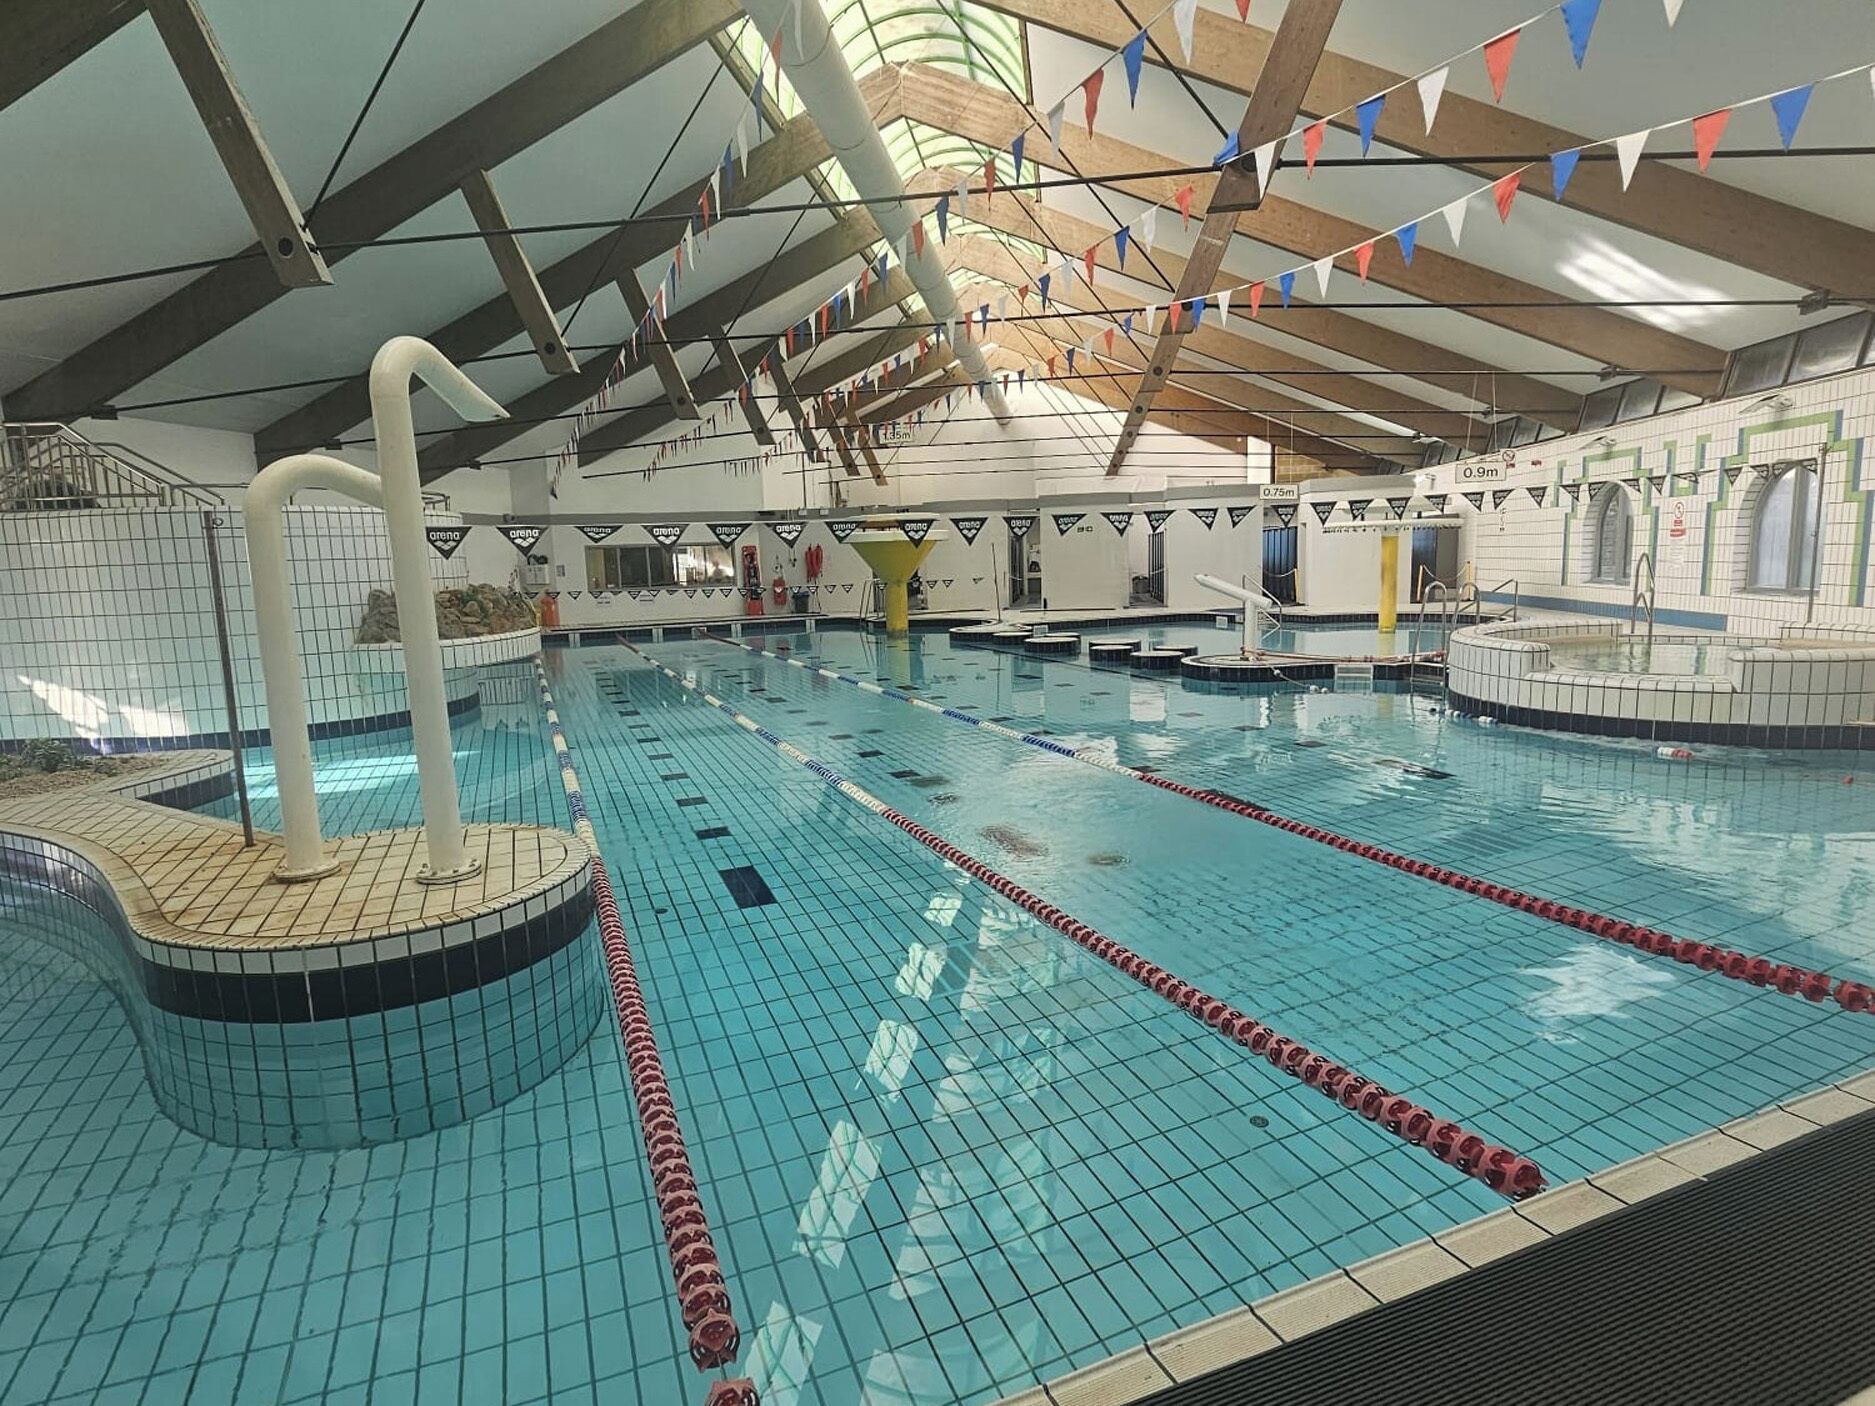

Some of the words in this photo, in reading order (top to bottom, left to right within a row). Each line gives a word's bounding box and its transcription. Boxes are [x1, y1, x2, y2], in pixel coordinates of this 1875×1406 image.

[1463, 466, 1498, 479] 0.9m
[1263, 487, 1295, 498] 0.75m
[716, 526, 742, 534] arena
[776, 524, 801, 533] arena
[833, 522, 856, 531] arena
[429, 530, 460, 541] arena
[509, 529, 540, 538] arena
[653, 527, 680, 536] arena
